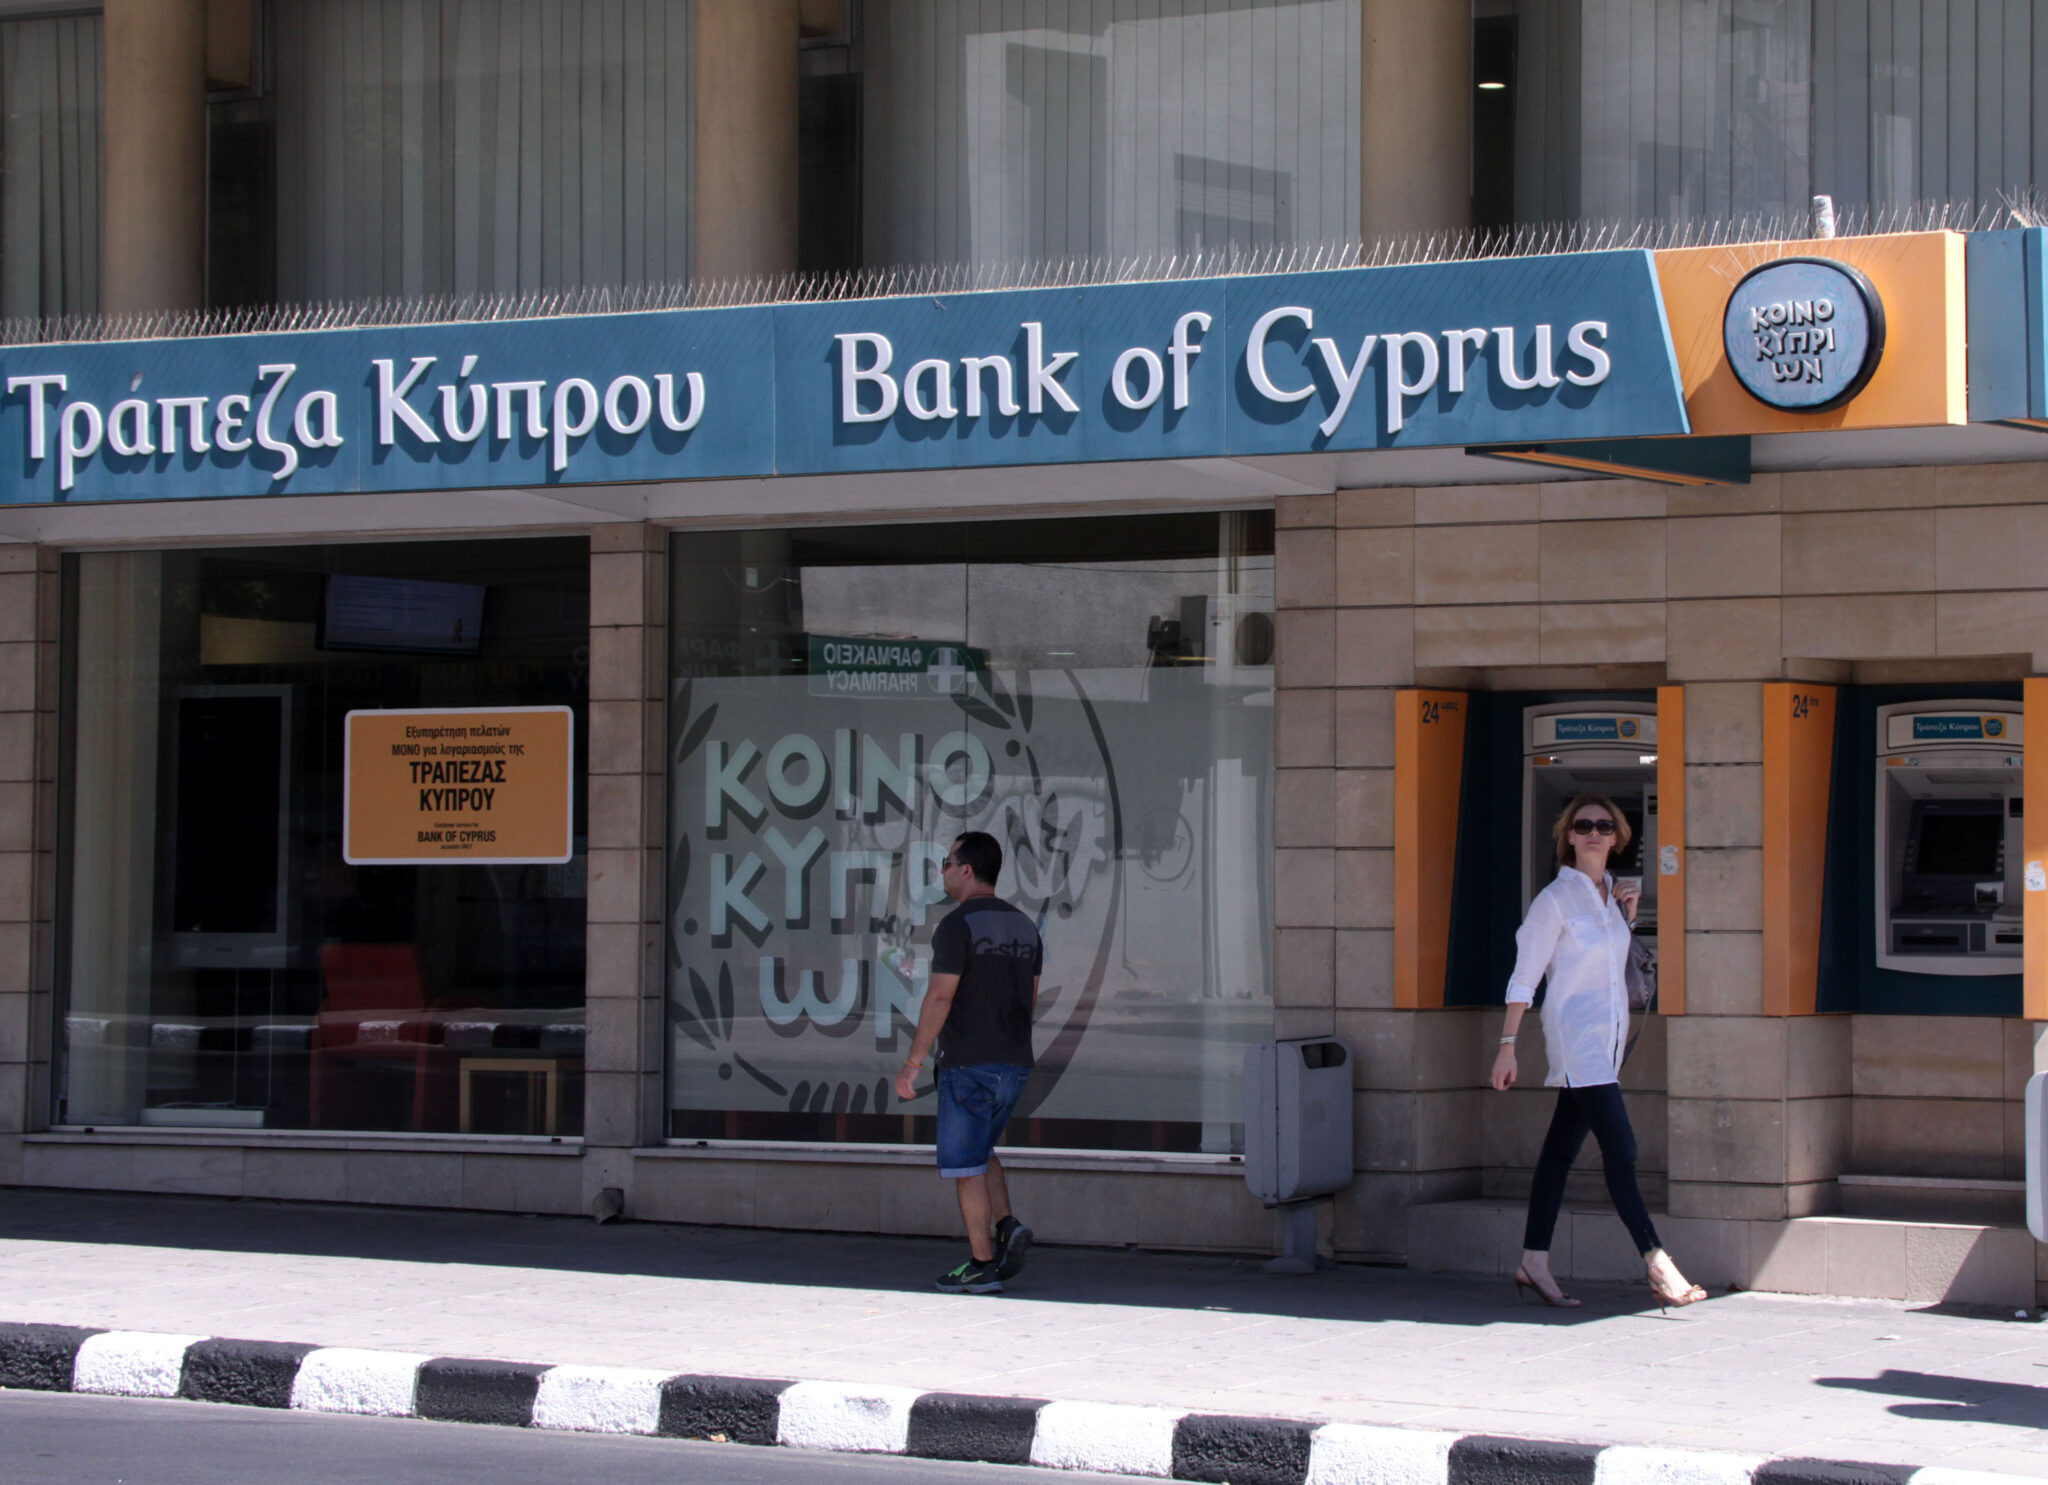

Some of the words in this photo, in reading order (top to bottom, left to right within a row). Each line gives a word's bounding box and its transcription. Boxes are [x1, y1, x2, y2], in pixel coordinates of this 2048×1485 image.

[1750, 298, 1834, 333] ΚΟΙΝΟ
[1754, 327, 1836, 362] ΚΥΠΡΙ
[834, 321, 1081, 424] Bank
[1111, 311, 1213, 411] of
[1246, 305, 1612, 438] Cyprus
[6, 363, 344, 490] Τράπεζα
[371, 354, 706, 472] Κύπρου
[1422, 700, 1440, 725] 24
[1792, 693, 1809, 719] 24
[405, 725, 467, 739] Εξυπηρέτηση
[470, 724, 511, 737] πελατών
[392, 744, 420, 756] ΜΟΝΟ
[423, 745, 437, 757] για
[440, 743, 505, 757] λογαριασμούς
[508, 743, 524, 756] της
[409, 760, 506, 784] ΤΡΑΠΕΖΑΣ
[705, 728, 993, 832] ΚΟΙΝΟ
[419, 787, 495, 812] ΚΥΠΡΟΥ
[417, 831, 443, 843] BANK
[445, 831, 457, 842] OF
[459, 830, 496, 842] CYPRUS
